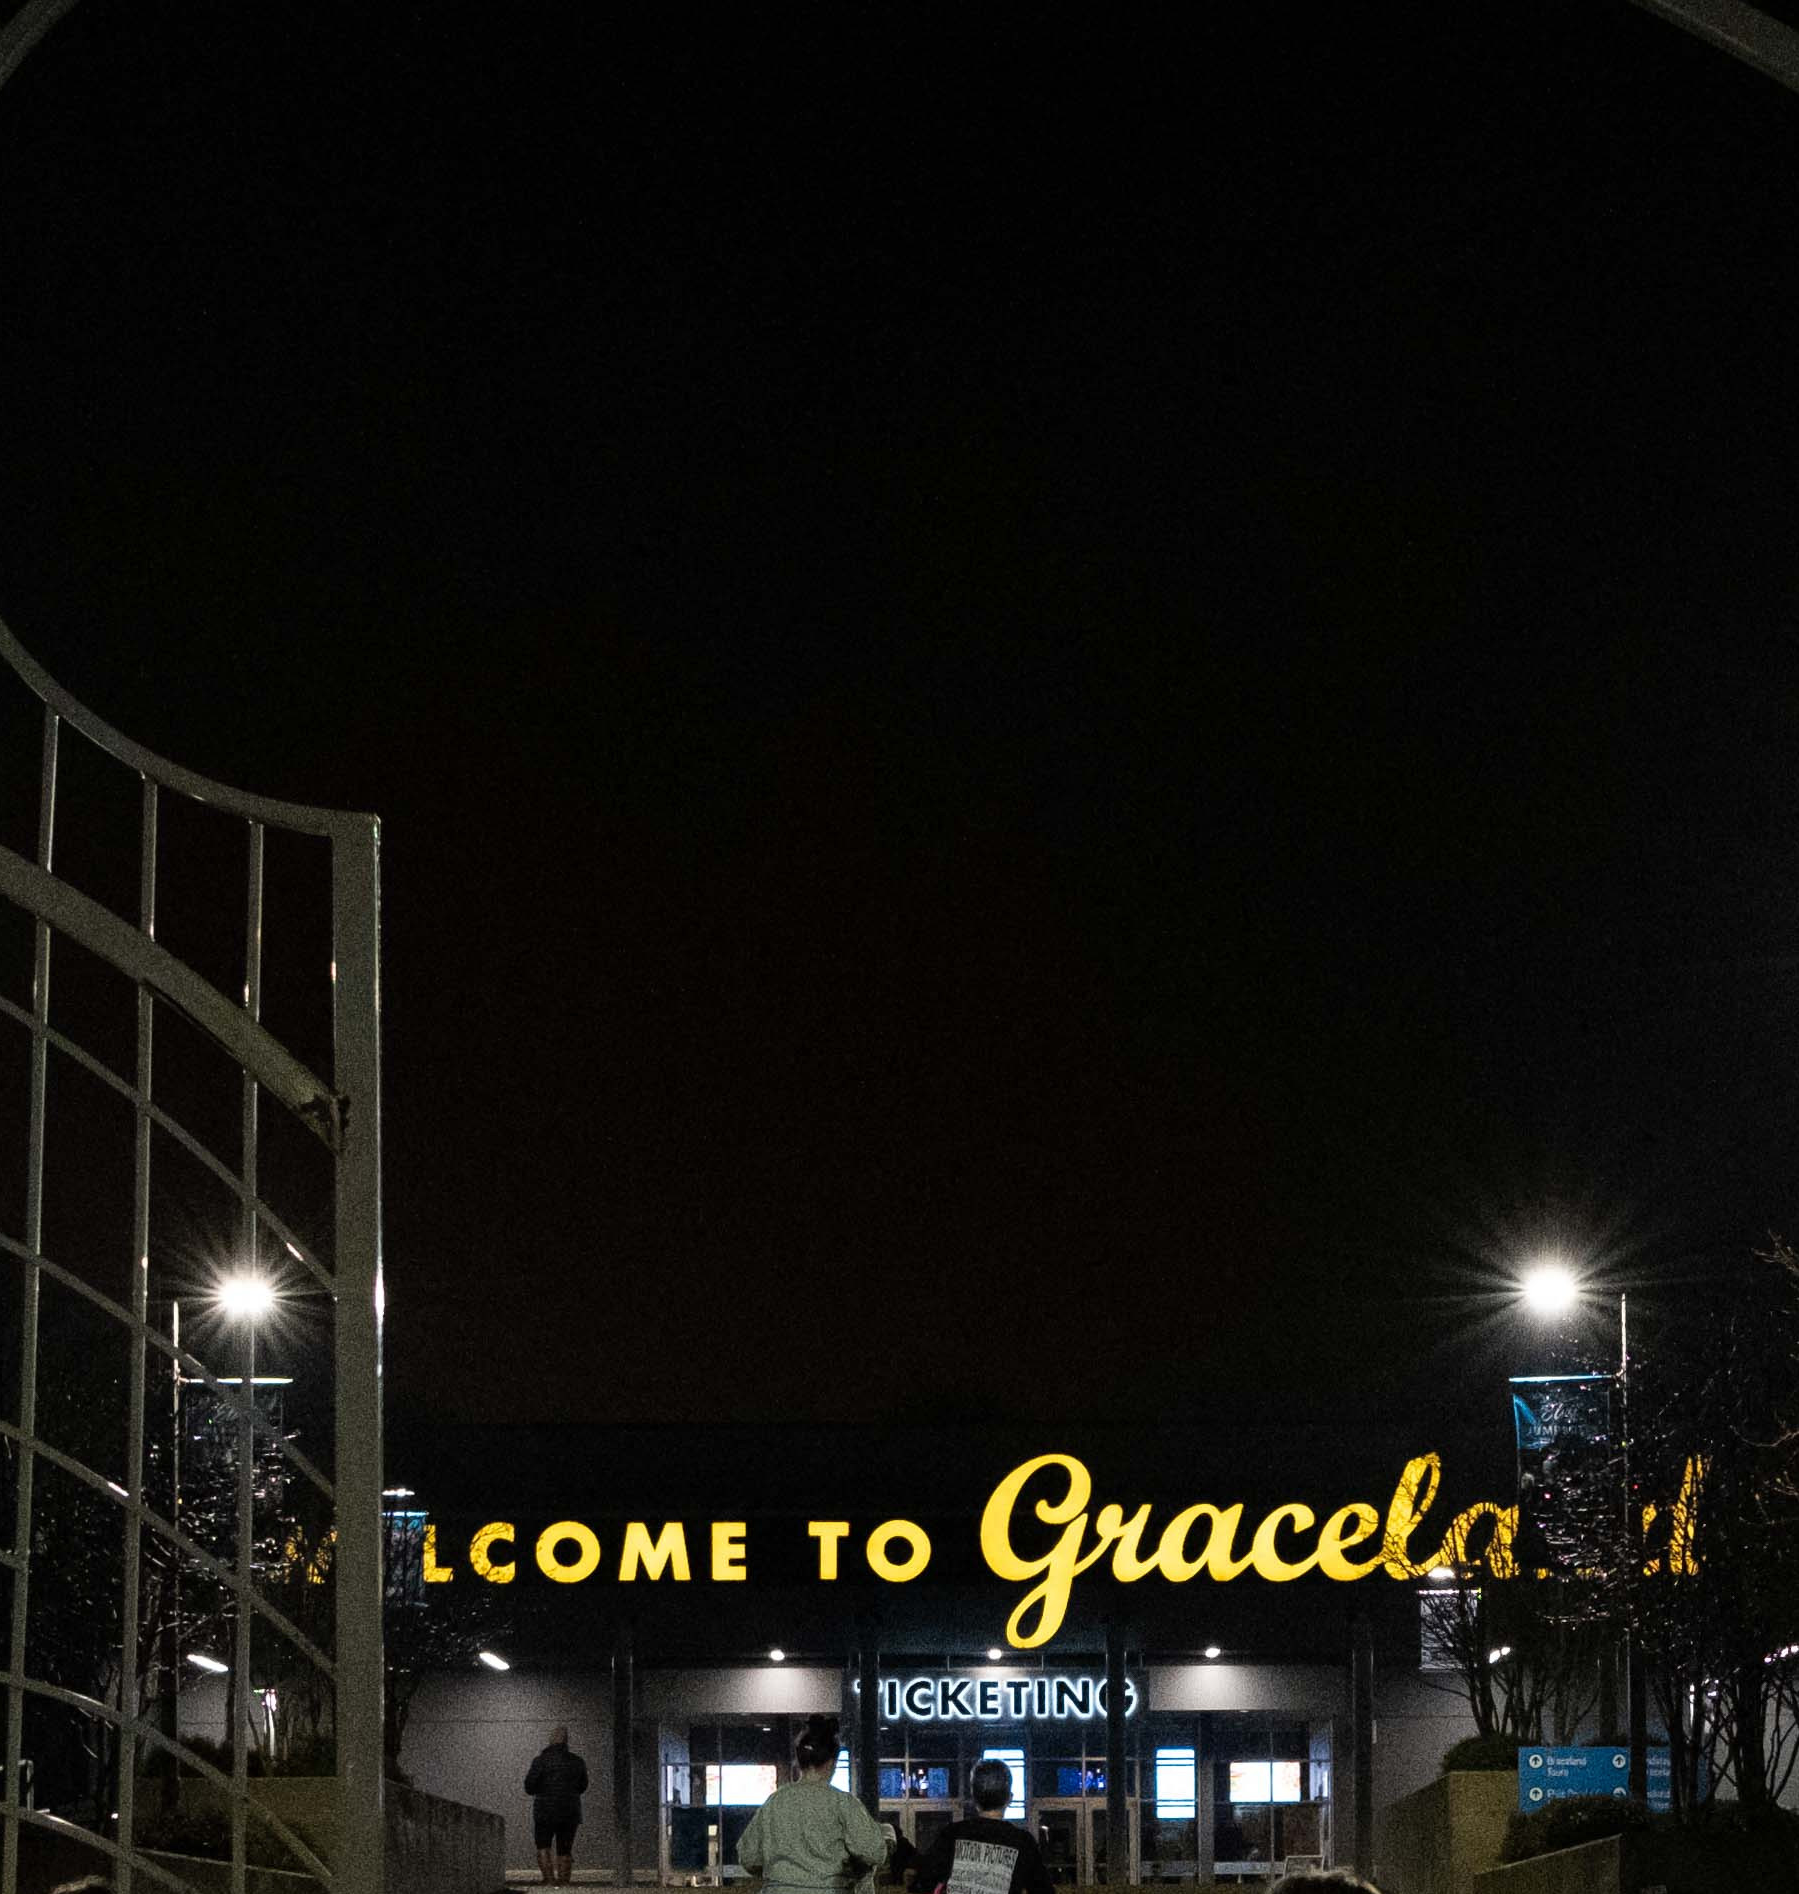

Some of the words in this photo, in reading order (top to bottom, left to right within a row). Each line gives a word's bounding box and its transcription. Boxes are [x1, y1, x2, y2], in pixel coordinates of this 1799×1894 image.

[285, 1518, 750, 1585] LCOME
[808, 1518, 933, 1583] TO
[979, 1451, 1708, 1650] Gracelad
[854, 1678, 1138, 1719] ICKETING
